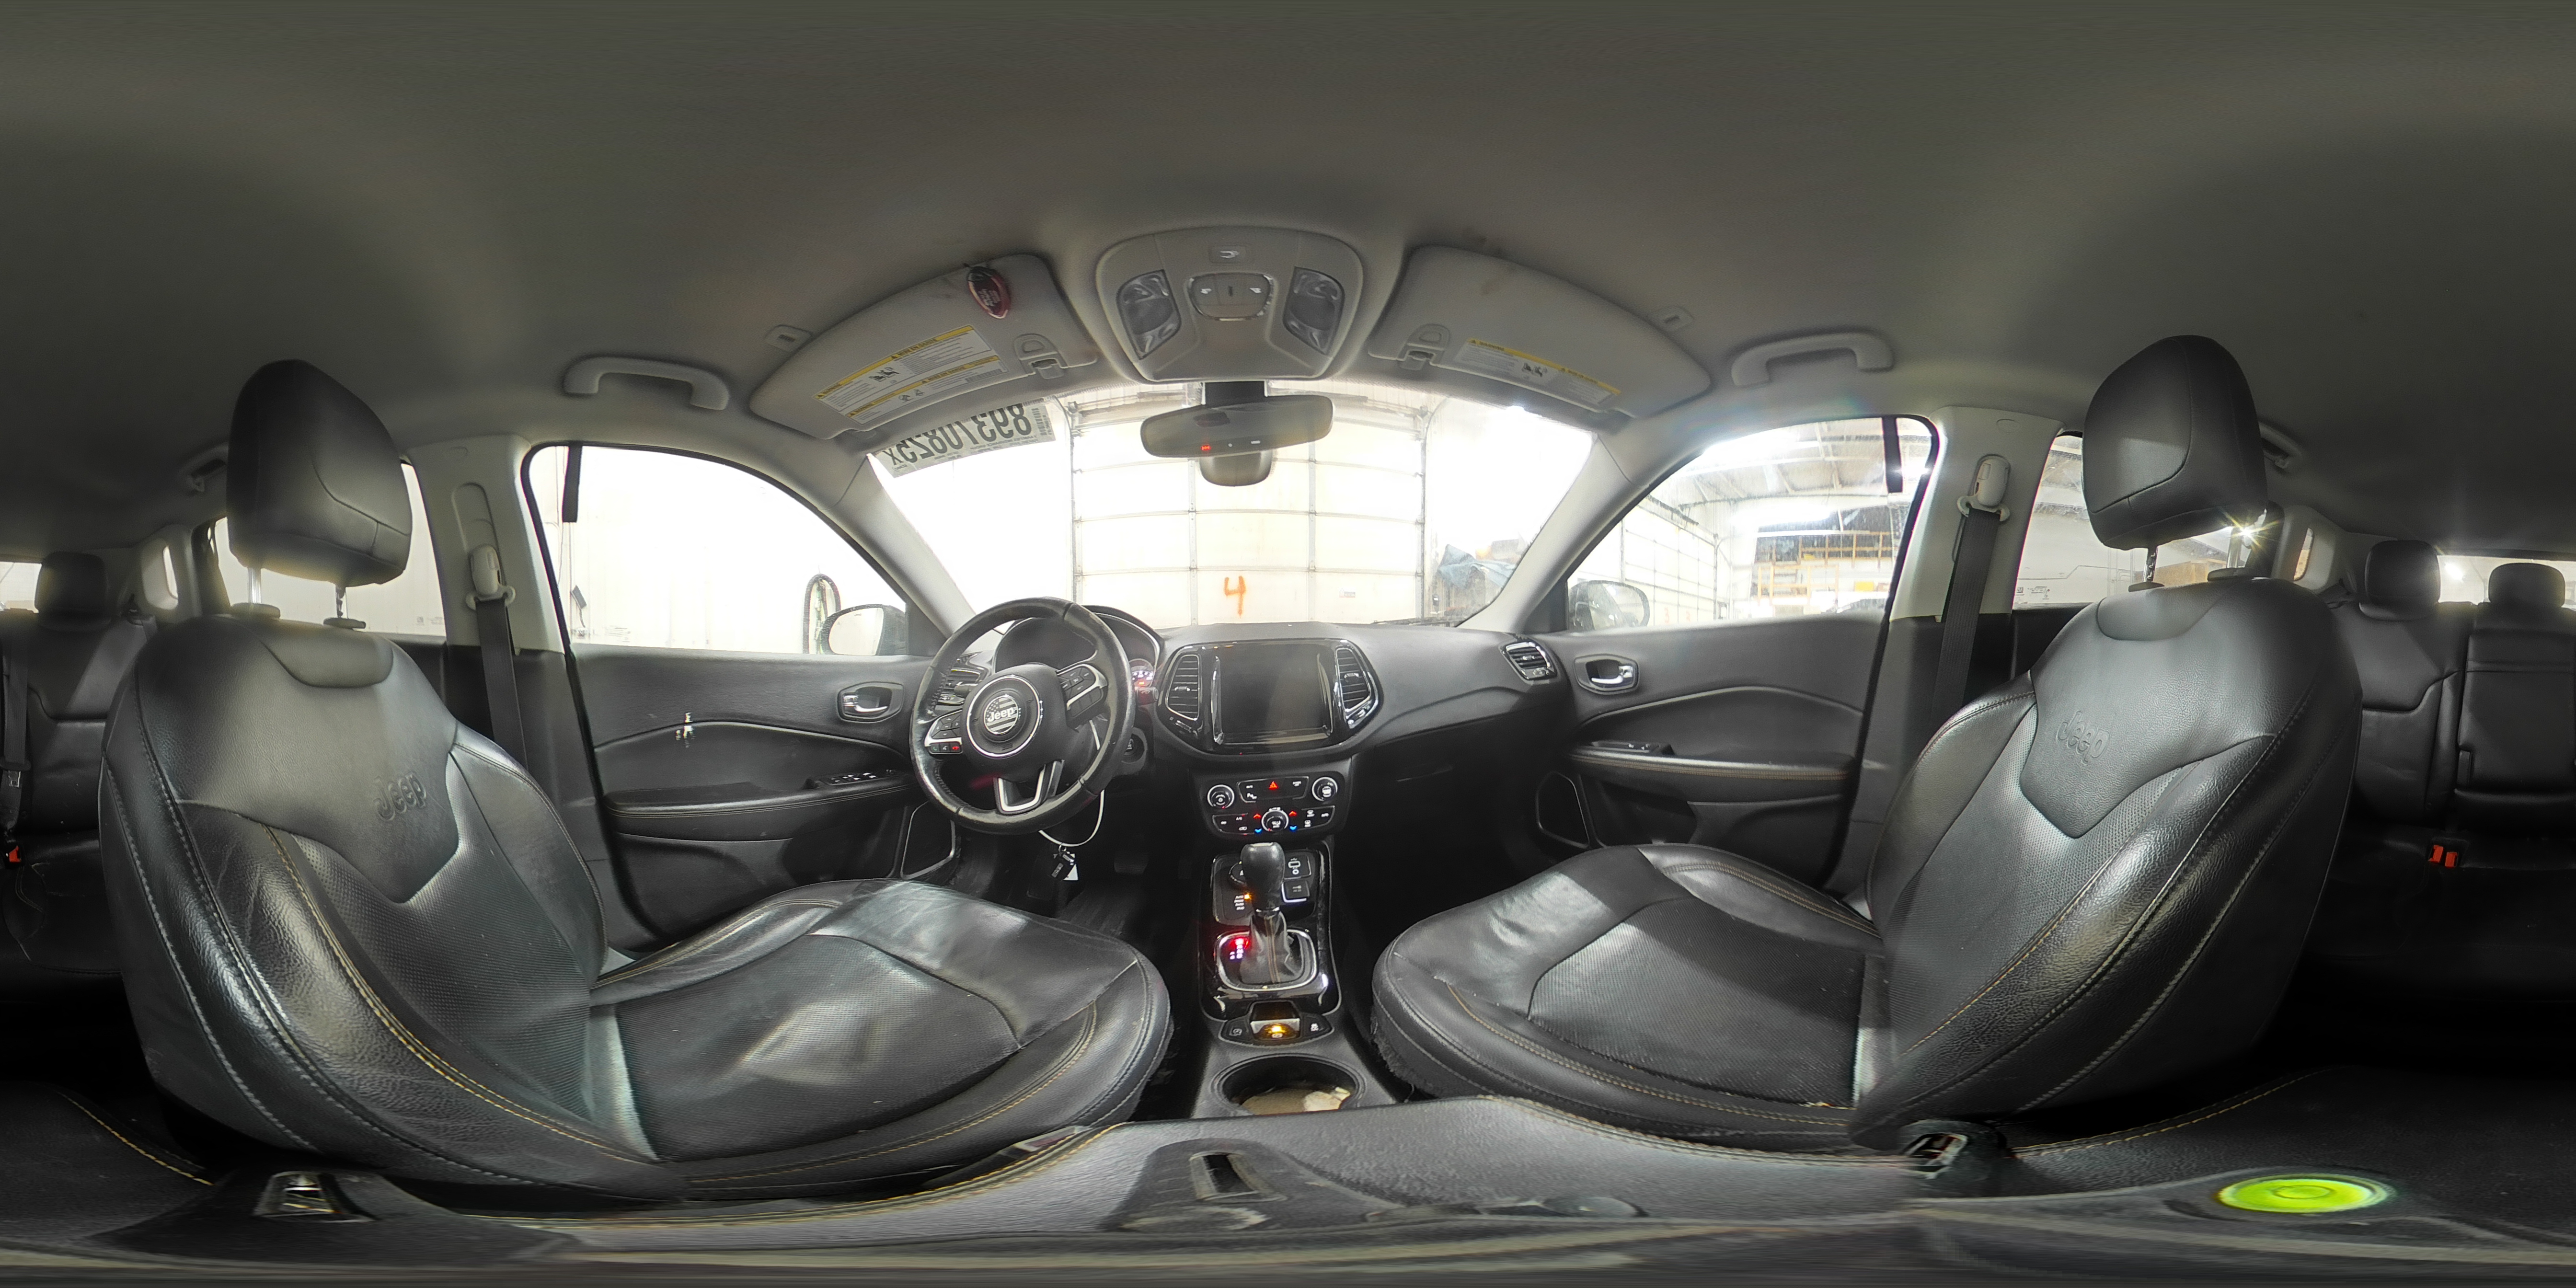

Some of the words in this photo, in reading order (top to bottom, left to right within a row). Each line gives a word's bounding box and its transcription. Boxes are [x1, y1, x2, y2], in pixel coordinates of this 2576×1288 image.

[1224, 575, 1246, 618] 4
[987, 707, 1014, 722] Jeep
[2056, 711, 2110, 765] Jeep
[373, 771, 426, 821] Jeep
